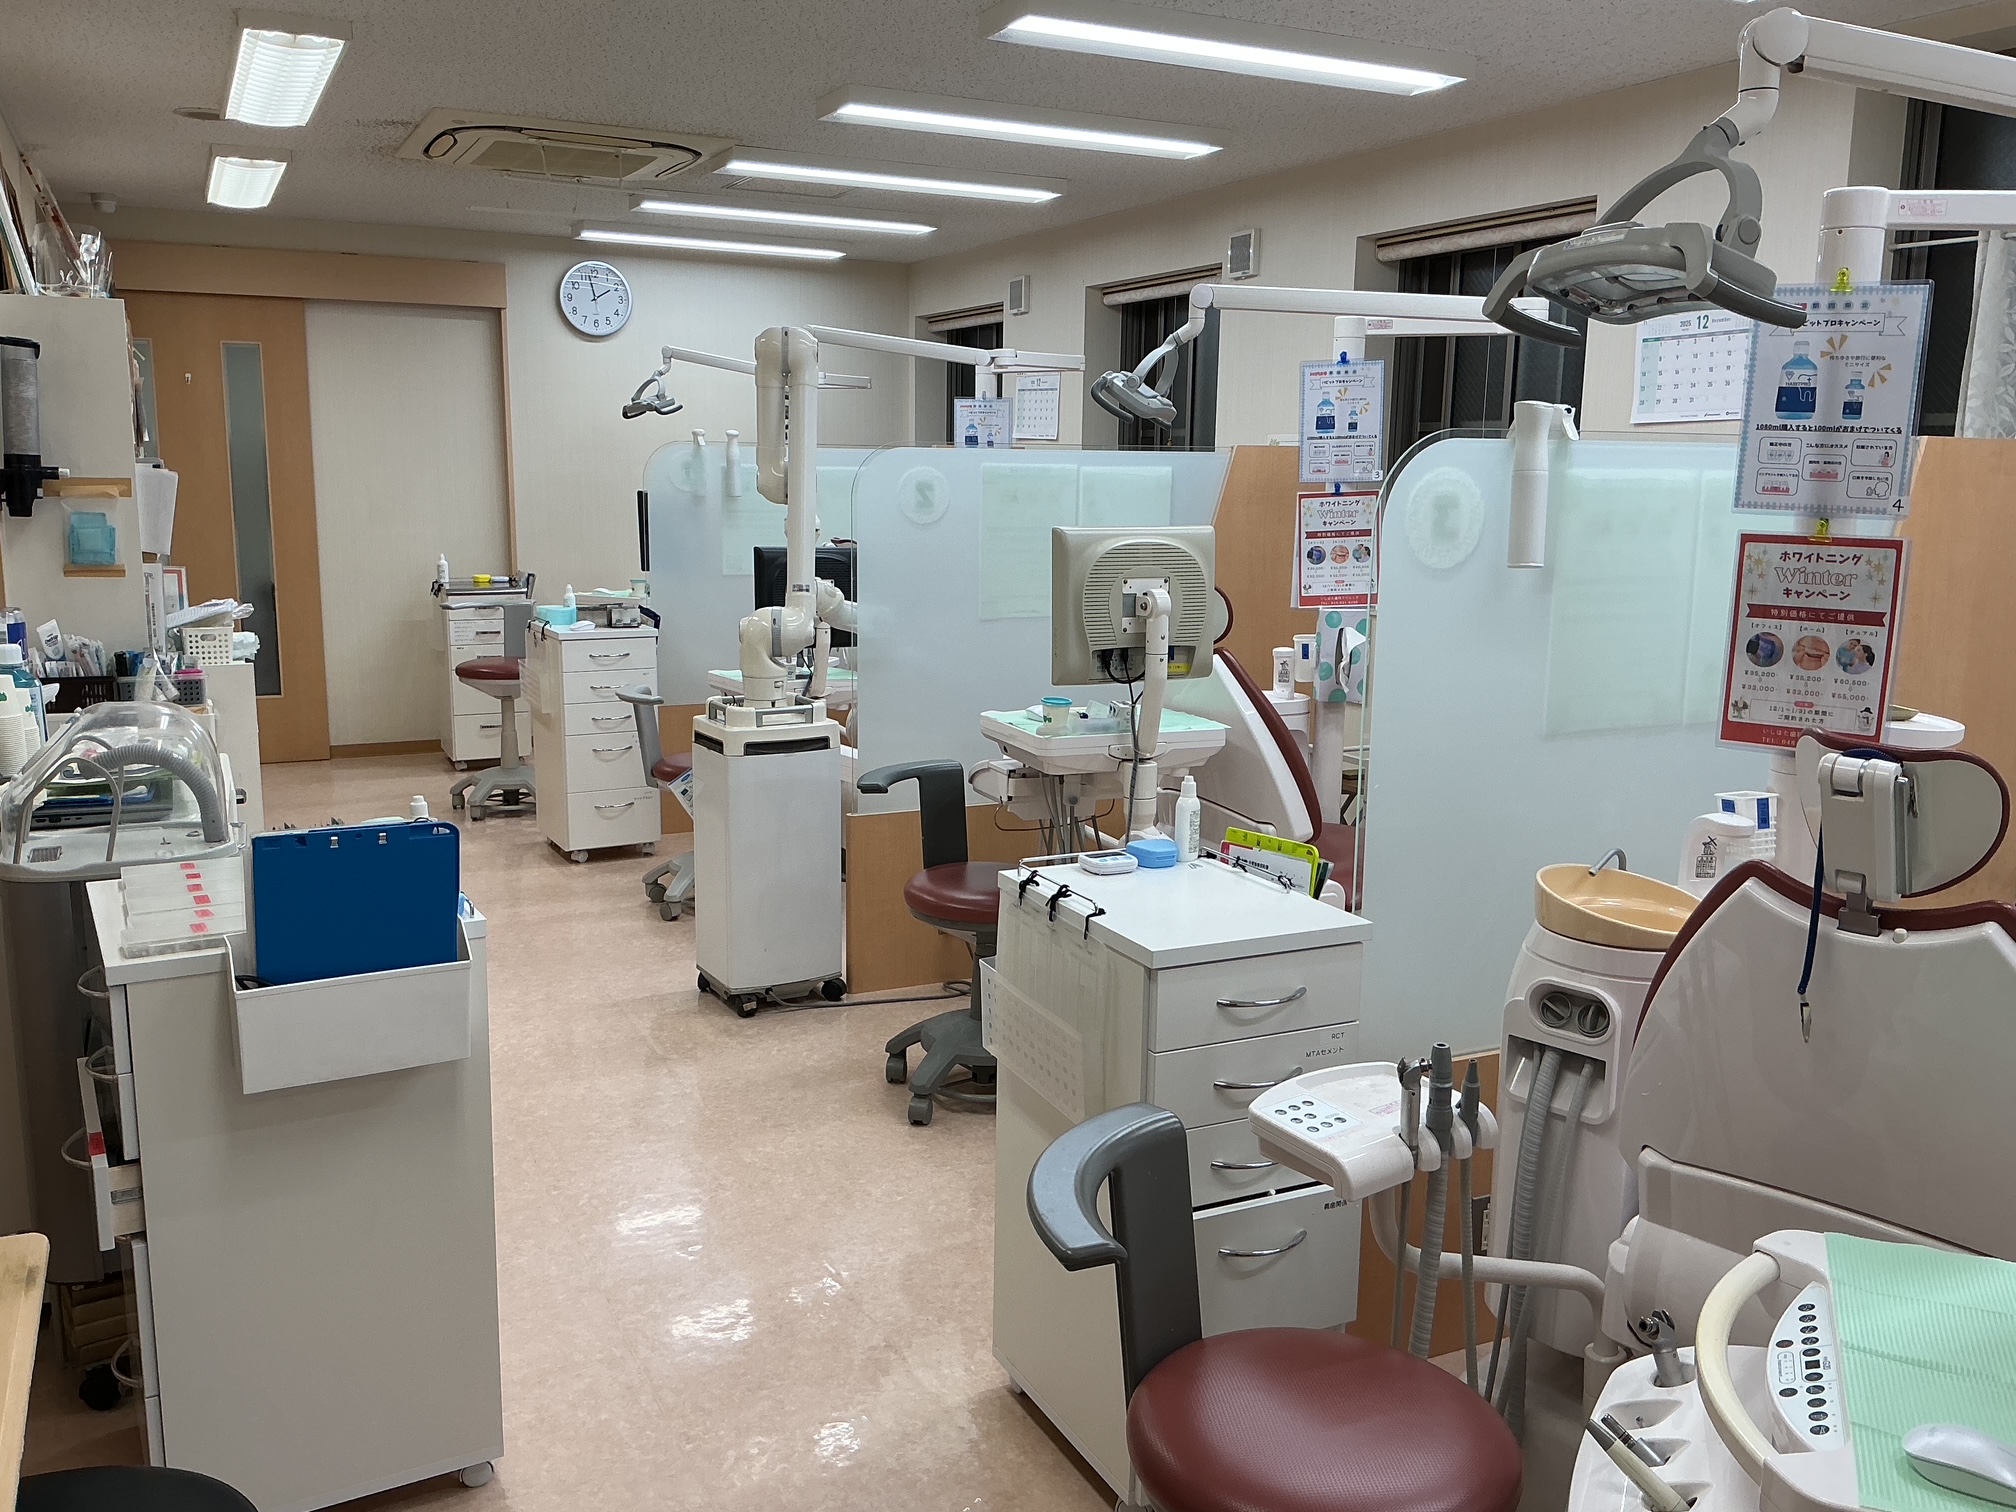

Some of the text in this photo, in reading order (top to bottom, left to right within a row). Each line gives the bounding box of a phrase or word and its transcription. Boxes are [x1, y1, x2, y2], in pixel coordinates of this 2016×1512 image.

[590, 269, 599, 278] 12
[605, 273, 609, 282] 1
[571, 281, 580, 290] 10
[613, 282, 620, 292] 2
[566, 293, 573, 302] 9
[618, 296, 624, 304] 3
[571, 306, 578, 315] 8
[613, 309, 620, 317] 4
[581, 315, 588, 324] 7
[593, 319, 600, 328] 6
[605, 316, 611, 326] 5
[1680, 320, 1692, 328] 2025
[1697, 314, 1709, 329] 12
[1374, 471, 1380, 479] 3
[1892, 498, 1905, 513] 4
[1317, 509, 1359, 519] Winter
[1779, 551, 1863, 565] ホワイトニング
[1774, 566, 1858, 587] Winter
[1783, 587, 1850, 600] キャンペーン
[1770, 608, 1855, 622] 特別価格にてご提供
[1777, 714, 1825, 725] ご契約された方
[1331, 1032, 1345, 1040] RCT
[1305, 1046, 1344, 1058] MTAセメント
